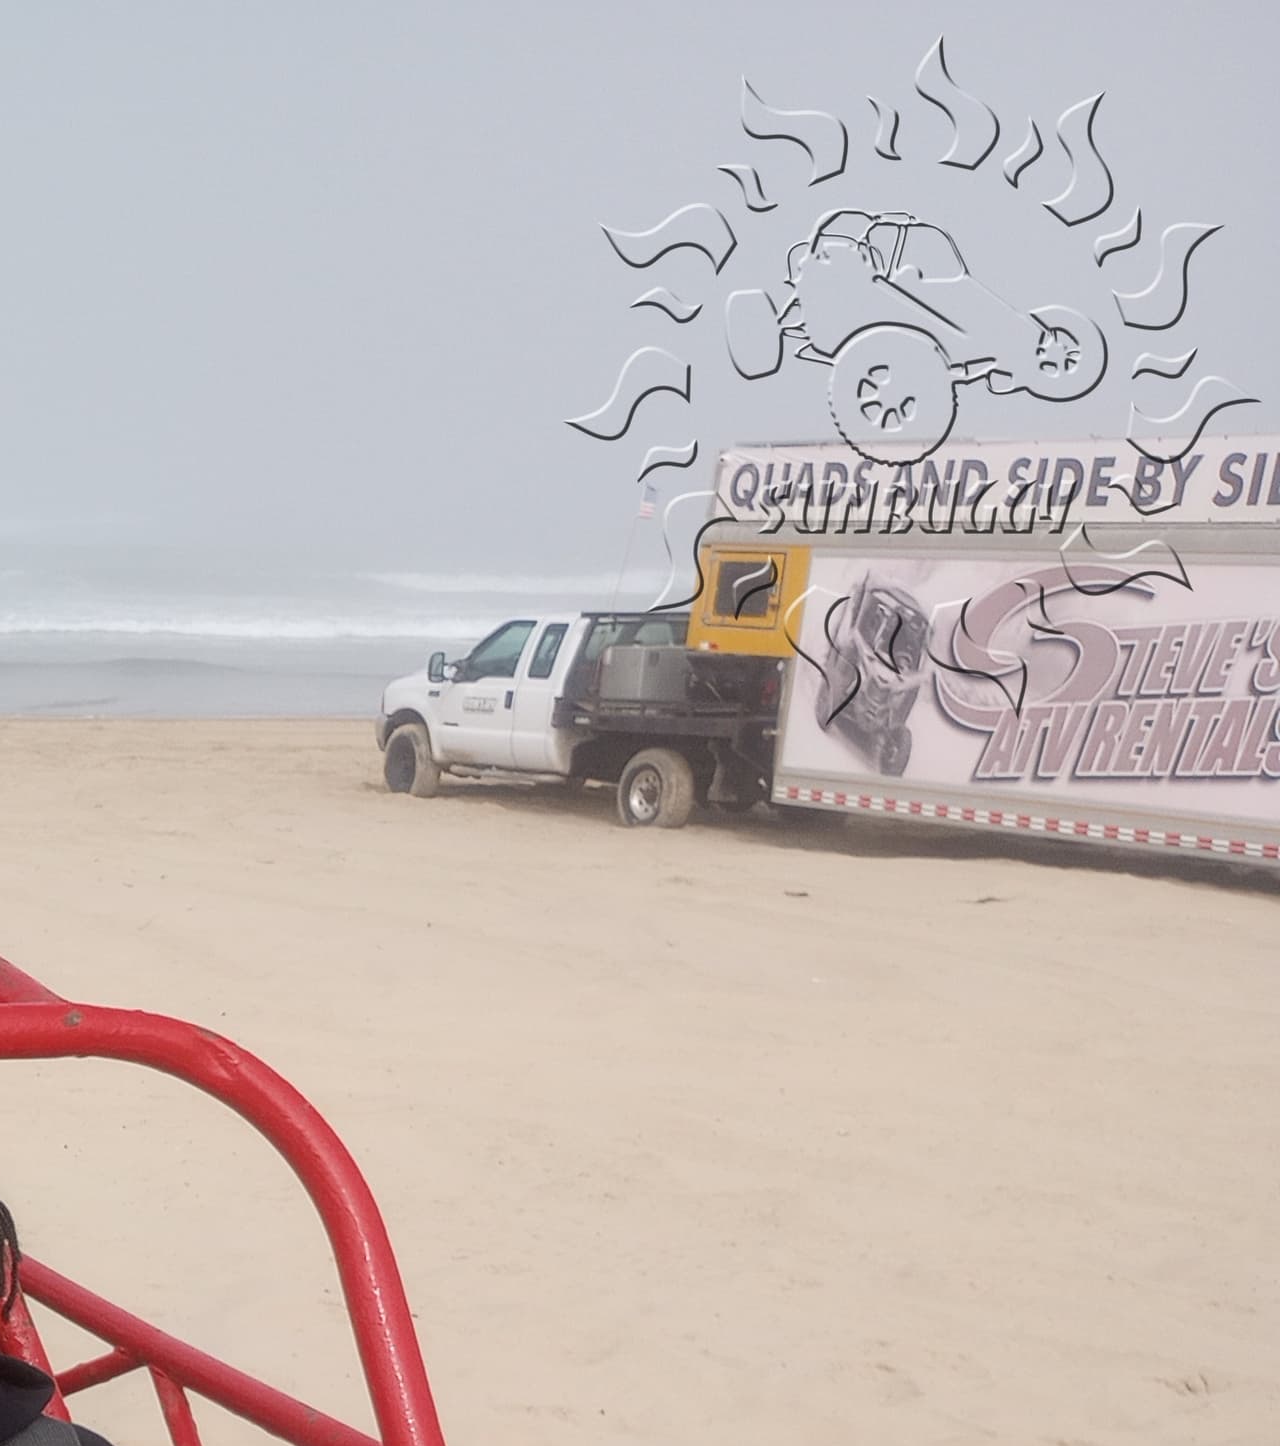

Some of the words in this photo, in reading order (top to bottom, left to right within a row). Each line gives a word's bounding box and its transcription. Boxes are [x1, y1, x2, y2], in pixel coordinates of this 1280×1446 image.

[730, 461, 873, 511] QUADS
[884, 459, 989, 506] AND
[1003, 457, 1117, 507] SIDE
[1131, 454, 1205, 507] BY
[974, 702, 1090, 779] ATV
